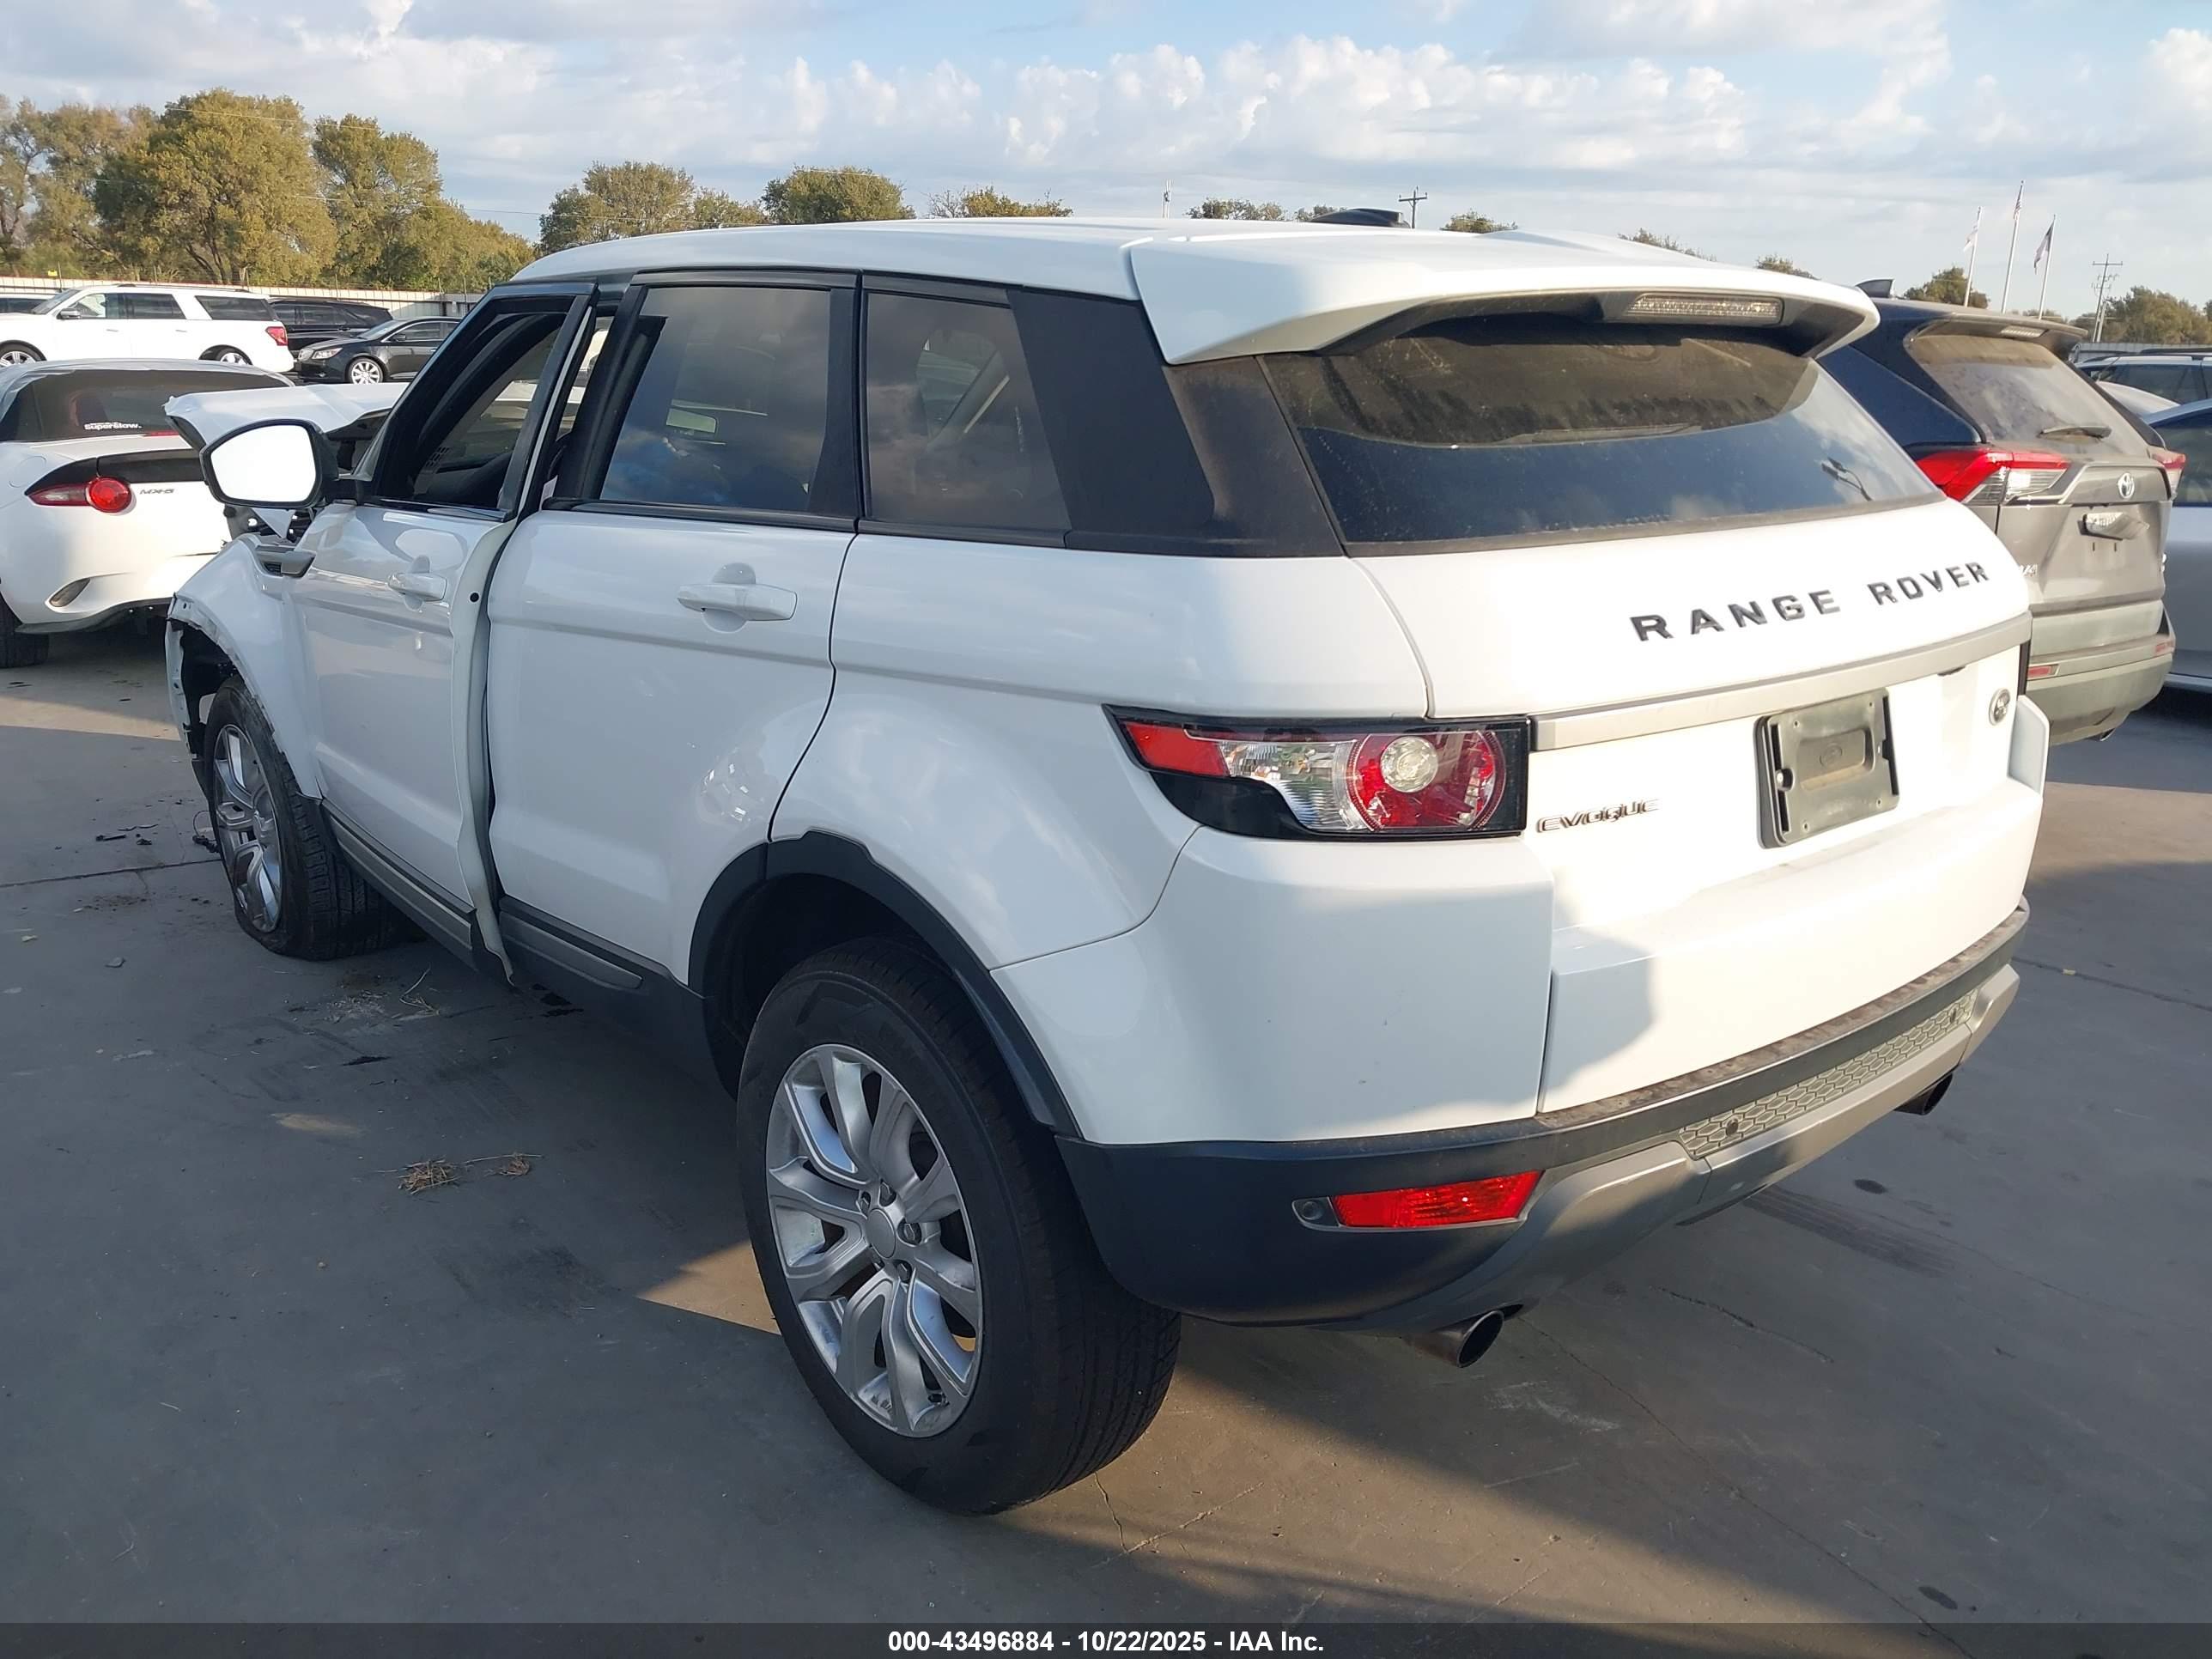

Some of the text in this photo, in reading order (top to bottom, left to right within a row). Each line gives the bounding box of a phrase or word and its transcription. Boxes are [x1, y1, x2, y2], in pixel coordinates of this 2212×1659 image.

[1630, 562, 1990, 641] RANGE ROVER
[1536, 798, 1660, 833] EVOQUE
